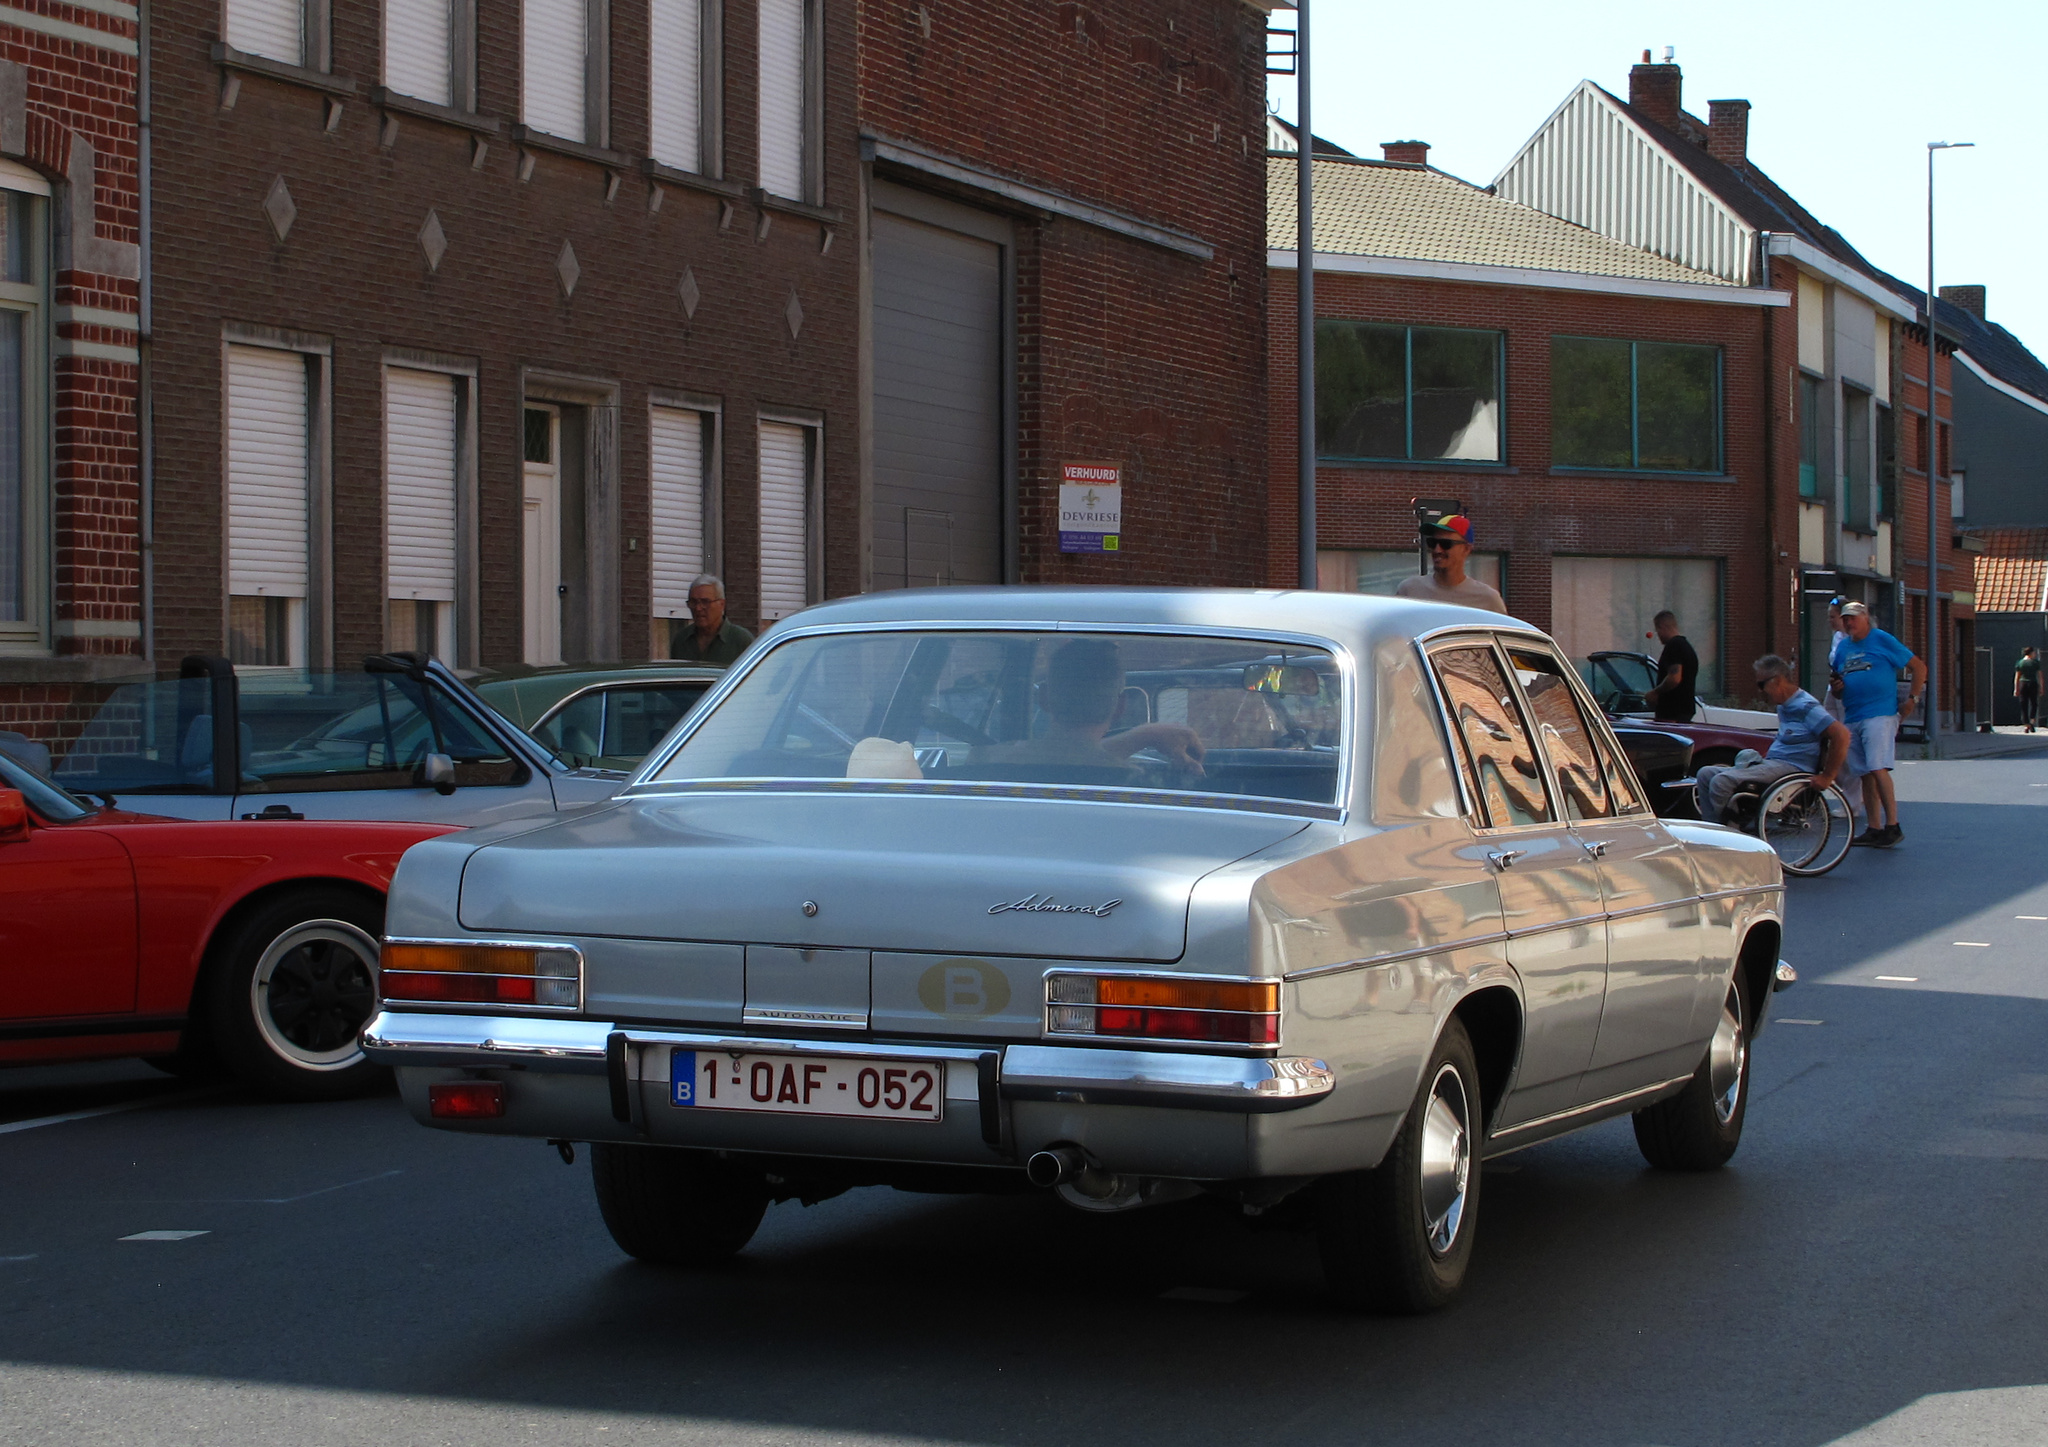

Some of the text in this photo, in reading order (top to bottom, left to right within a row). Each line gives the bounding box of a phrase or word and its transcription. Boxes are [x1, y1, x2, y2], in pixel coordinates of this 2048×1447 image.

[1062, 511, 1119, 522] DEVRIESE
[987, 892, 1123, 918] Admiral
[945, 967, 988, 1014] B
[758, 1010, 853, 1021] AUTOMATIC
[677, 1081, 692, 1101] B
